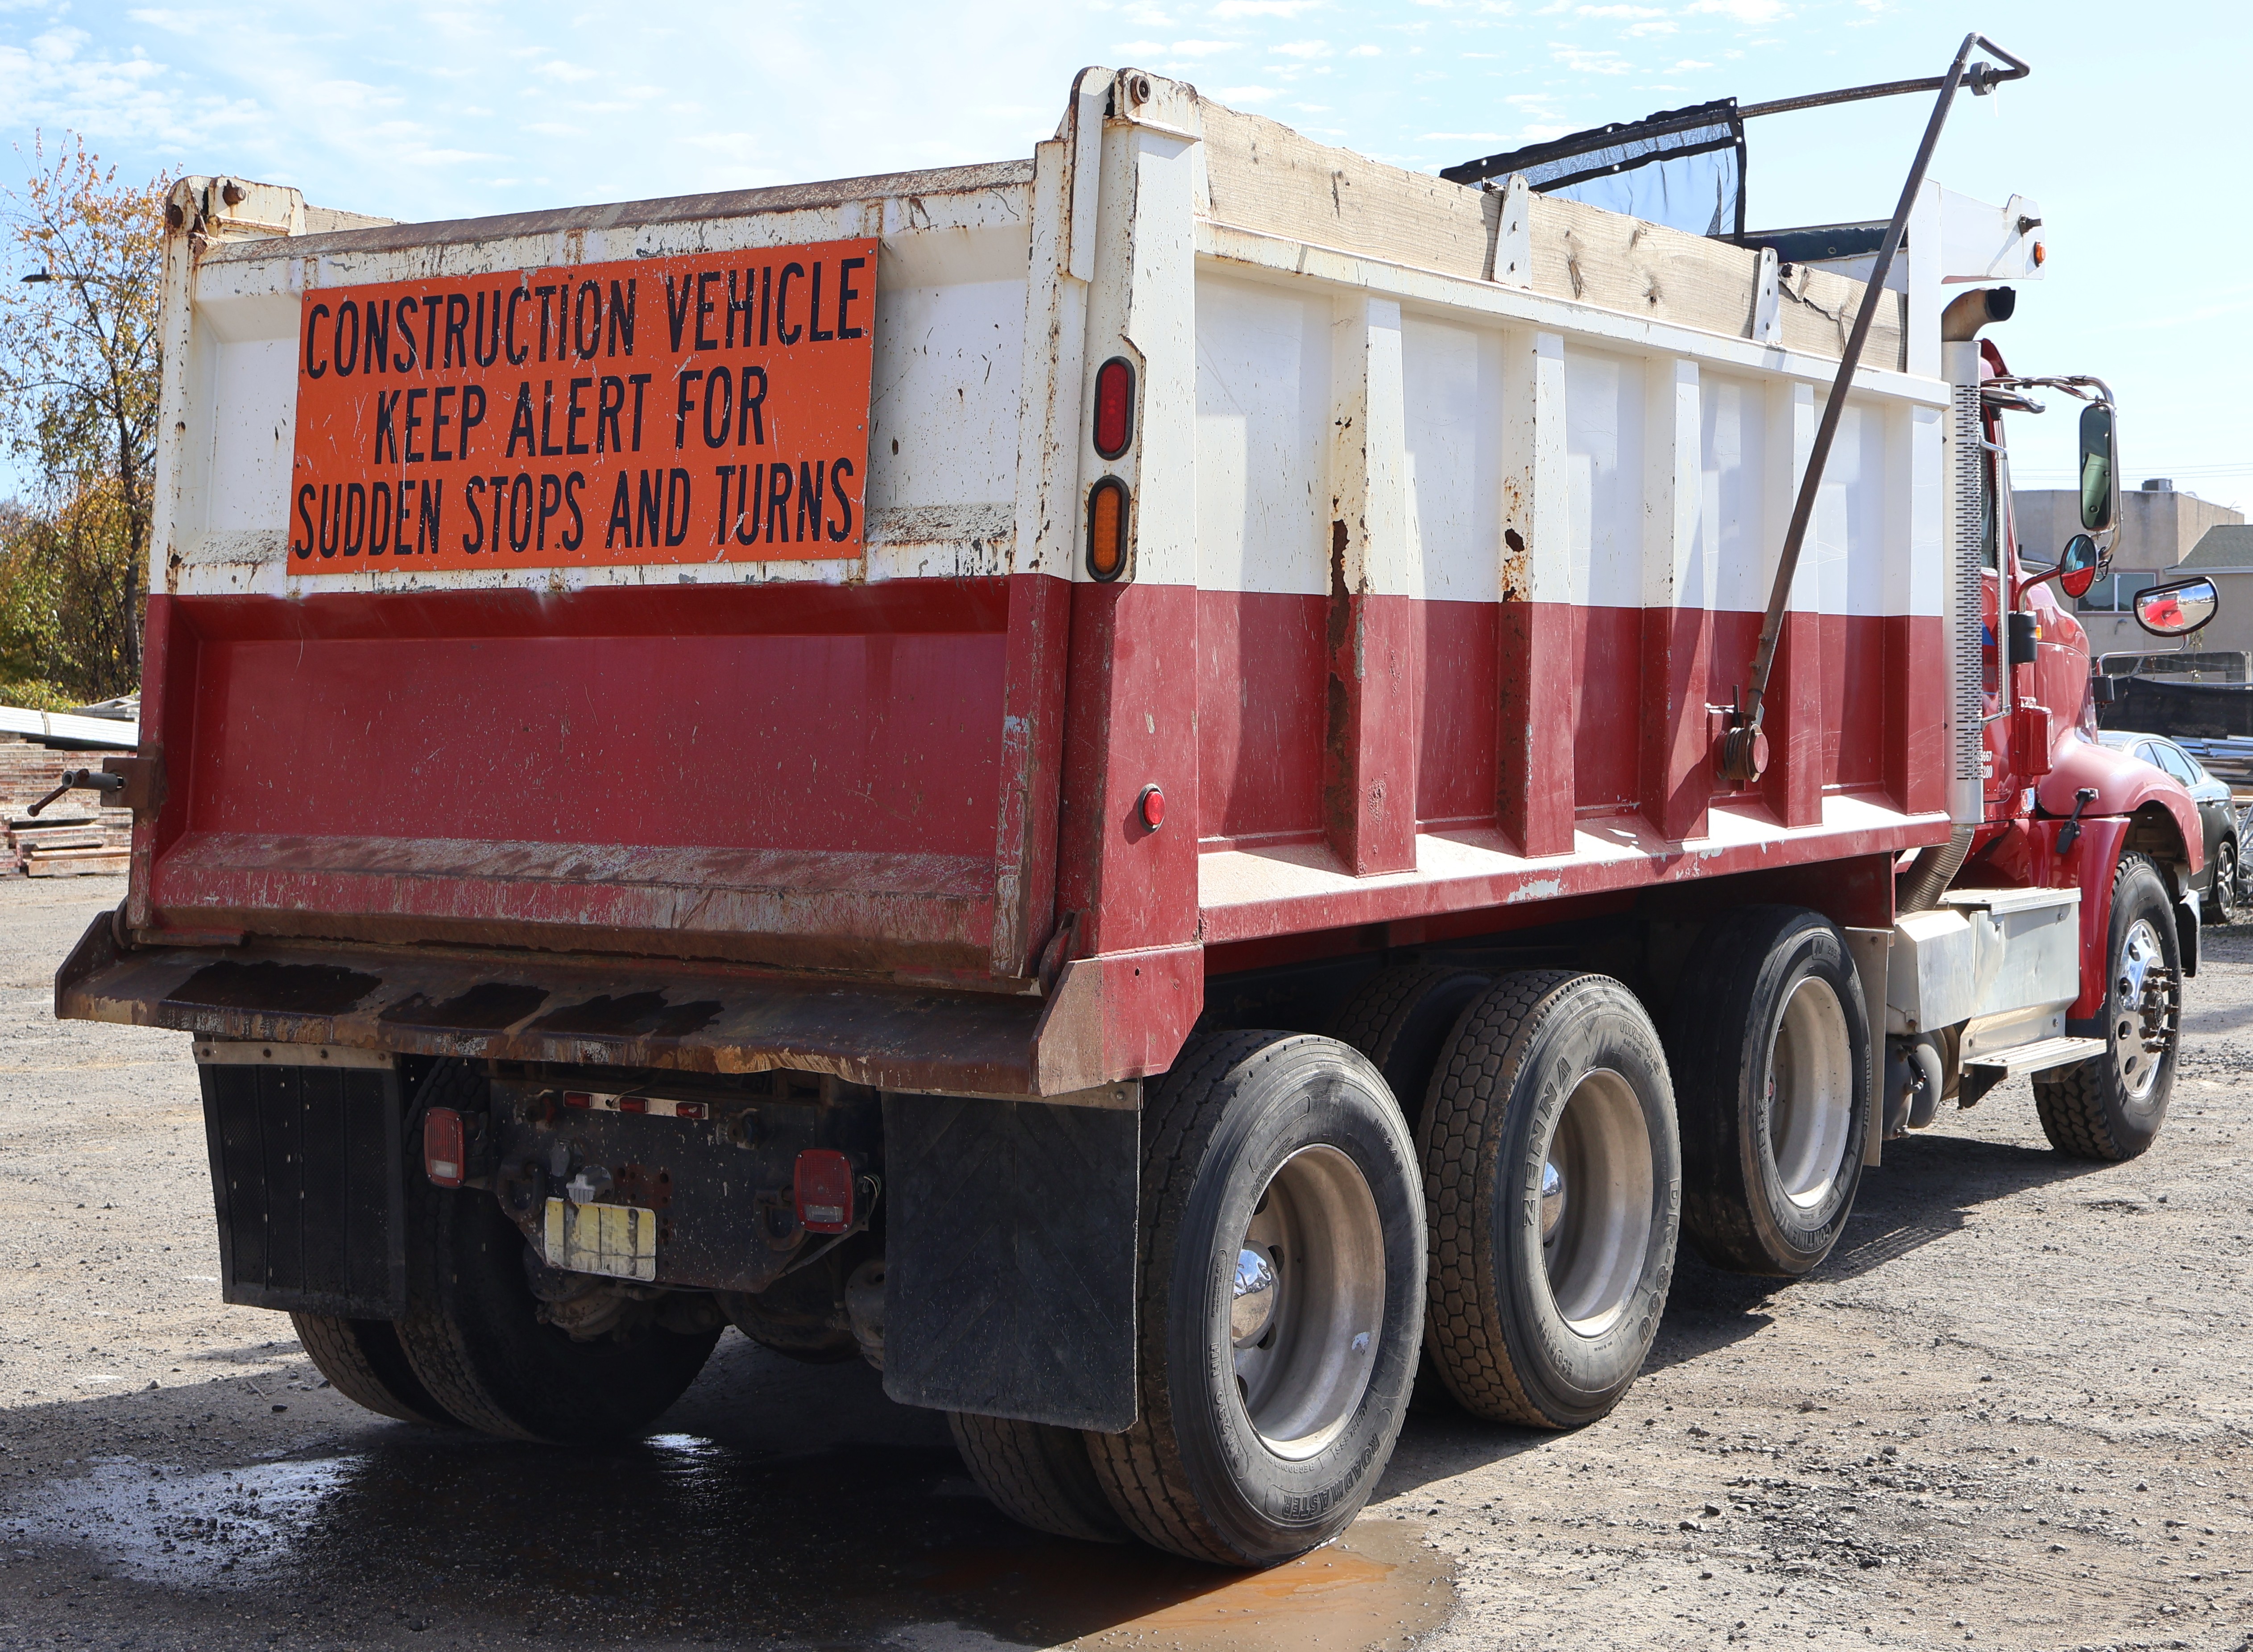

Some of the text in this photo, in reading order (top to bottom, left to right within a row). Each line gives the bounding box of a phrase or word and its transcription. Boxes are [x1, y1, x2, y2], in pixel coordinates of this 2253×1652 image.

[307, 257, 865, 379] CONSTRUCTION VEHICLE
[375, 366, 768, 464] KEEP ALERT FOR
[295, 458, 853, 559] SUDDEN STOPS AND TURNS
[1981, 750, 1992, 762] 667
[1981, 765, 1993, 778] 280
[1523, 1056, 1572, 1226] ZENNA
[1638, 1179, 1681, 1345] DR-850
[1773, 1201, 1832, 1249] CONTINENTAL
[1259, 1447, 1315, 1474] REGROOVABLE
[1282, 1432, 1381, 1517] ROADMASTER
